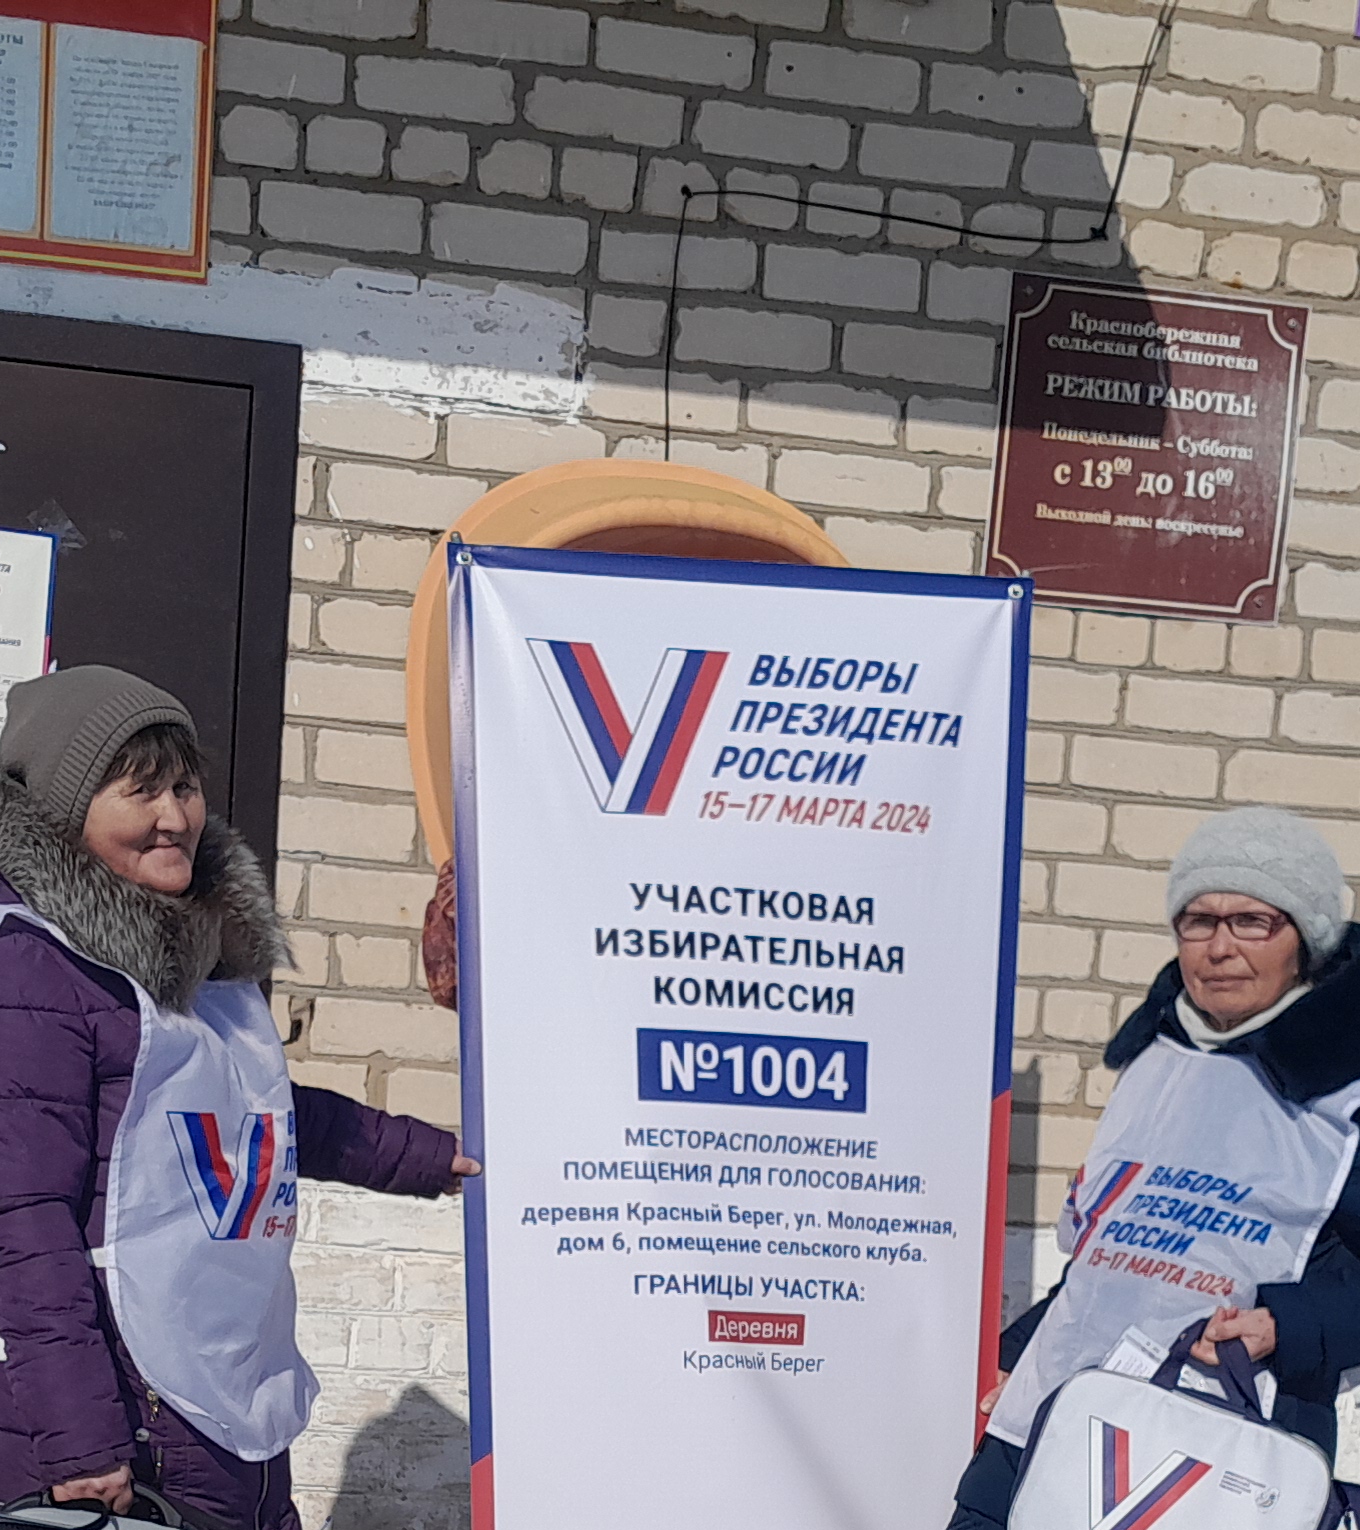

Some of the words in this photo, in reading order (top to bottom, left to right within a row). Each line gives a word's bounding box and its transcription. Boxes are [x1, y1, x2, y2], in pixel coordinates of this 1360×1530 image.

[1070, 310, 1242, 349] Краснобережная
[1047, 332, 1138, 357] сельская
[1143, 341, 1259, 372] библиотека
[1045, 373, 1141, 405] РЕЖИМ
[1146, 386, 1258, 418] РАБОТЫ:
[1042, 421, 1161, 451] Понедельник
[1136, 472, 1174, 498] до
[1035, 503, 1112, 526] Выходной
[1155, 518, 1244, 538] воскресенье
[746, 652, 920, 696] ВЫБОРЫ
[729, 698, 965, 749] ПРЕЗИДЕНТА
[711, 746, 869, 787] РОССИИ
[775, 795, 865, 831] МАРТА
[870, 801, 933, 835] 2024
[630, 882, 875, 926] УЧАСТКОВАЯ
[594, 927, 906, 975] ИЗБИРАТЕЛЬНАЯ
[653, 976, 855, 1017] КОМИССИЯ
[659, 1040, 850, 1102] №1004
[624, 1127, 879, 1160] МЕСТОРАСПОЛОЖЕНИЕ
[563, 1160, 713, 1186] ПОМЕЩЕНИЯ
[718, 1164, 762, 1189] ДЛЯ
[767, 1167, 927, 1196] ГОЛОСОВАНИЯ:
[1144, 1165, 1253, 1204] ВЫБОРЫ
[520, 1203, 620, 1226] деревня
[626, 1201, 722, 1227] Красный
[728, 1205, 790, 1230] Берег,
[794, 1211, 822, 1232] ул.
[828, 1210, 958, 1239] Молодежная,
[1101, 1220, 1196, 1256] РОССИИ
[1123, 1193, 1273, 1246] ПРЕЗИДЕНТА
[556, 1235, 607, 1256] дом
[612, 1233, 632, 1255] 6,
[638, 1234, 762, 1256] помещение
[767, 1240, 862, 1260] сельского
[866, 1242, 928, 1265] клуба.
[633, 1274, 754, 1298] ГРАНИЦЫ
[760, 1277, 865, 1302] УЧАСТКА:
[1123, 1254, 1187, 1285] МАРТА
[1184, 1270, 1236, 1297] 2024
[714, 1314, 798, 1341] Деревня
[683, 1350, 767, 1373] Красный
[771, 1353, 825, 1376] Берег
